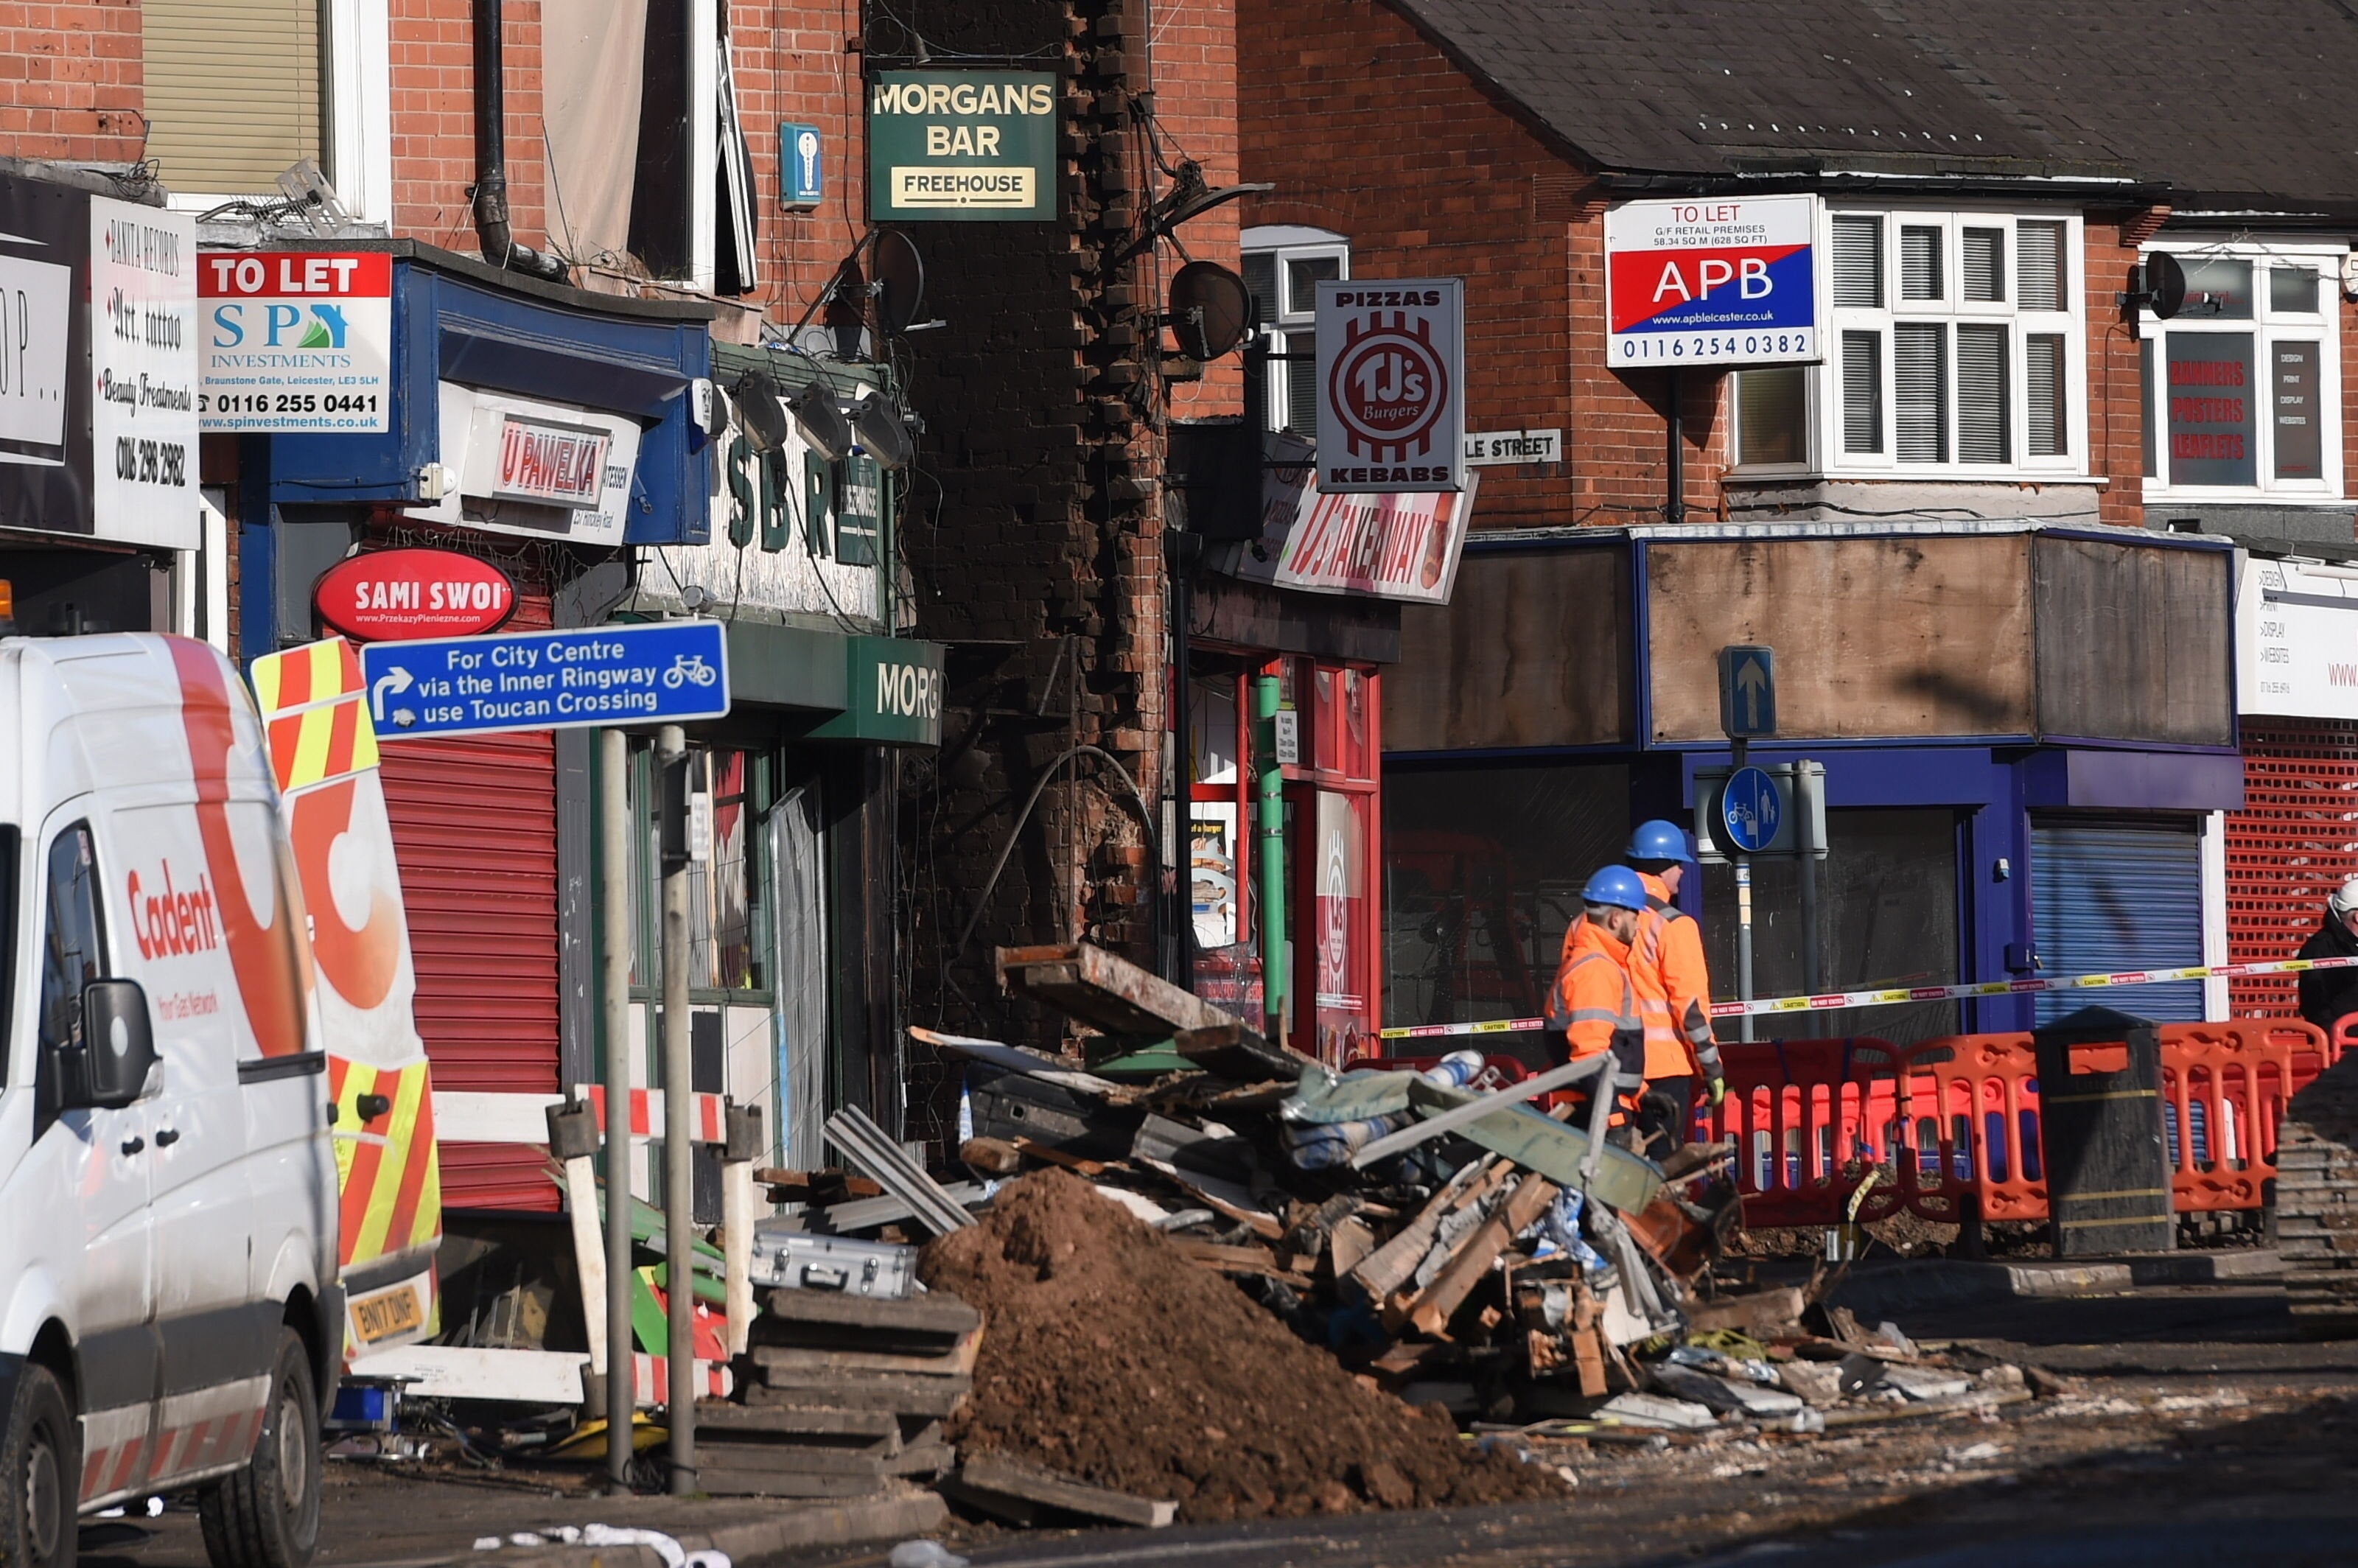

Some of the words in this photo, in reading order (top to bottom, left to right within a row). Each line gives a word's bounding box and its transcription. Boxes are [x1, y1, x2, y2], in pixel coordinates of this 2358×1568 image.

[873, 83, 1052, 115] MORGANS
[926, 125, 1001, 156] BAR
[904, 175, 1023, 192] FREEHOUSE
[1671, 206, 1698, 223] TO
[1706, 205, 1740, 222] LET
[1654, 237, 1679, 246] 58.34
[1682, 237, 1696, 245] SQ
[1699, 237, 1708, 245] M
[1711, 236, 1732, 245] (628
[1735, 235, 1749, 245] SQ
[1752, 234, 1768, 245] FT)
[1655, 227, 1673, 236] G/F
[1676, 225, 1710, 235] RETAIL
[1713, 225, 1766, 234] PREMISES
[144, 226, 179, 277] RECORDS
[211, 258, 265, 293] TO
[279, 258, 358, 293] LET
[1651, 258, 1773, 303] APB
[1335, 291, 1441, 308] PIZZAS
[145, 295, 181, 352] tattoo
[1652, 309, 1774, 326] www.apbleicester.co.uk
[1623, 338, 1684, 358] 0116
[1693, 337, 1736, 356] 254
[1745, 334, 1805, 354] 0382
[211, 354, 351, 368] INVESTMENTS
[2169, 360, 2245, 387] BANNERS
[102, 366, 137, 419] Beauty
[139, 371, 192, 413] Treatments
[205, 376, 256, 385] Braunstone
[259, 376, 284, 387] Gate,
[287, 376, 335, 387] Leicester,
[338, 377, 357, 385] LE3
[360, 376, 379, 385] 5LH
[217, 394, 269, 413] 0116
[276, 394, 316, 413] 255
[323, 394, 377, 413] 0441
[1362, 404, 1419, 421] Burgers
[2171, 396, 2245, 423] POSTERS
[1491, 437, 1553, 457] STREET
[2173, 433, 2245, 460] LEAFLETS
[1330, 466, 1449, 483] KEBABS
[840, 483, 877, 518] FREEHOUSE
[355, 581, 419, 610] SAMI
[430, 581, 502, 610] SWOI
[447, 648, 483, 671] For
[491, 643, 539, 668] City
[546, 641, 626, 663] Centre
[418, 680, 451, 698] via
[456, 673, 494, 695] the
[499, 670, 555, 693] Inner
[564, 665, 657, 693] Ringway
[876, 662, 940, 720] MORG
[424, 706, 463, 724] use
[470, 698, 550, 721] Toucan
[556, 690, 658, 714] Crossing
[127, 858, 217, 961] Cadent
